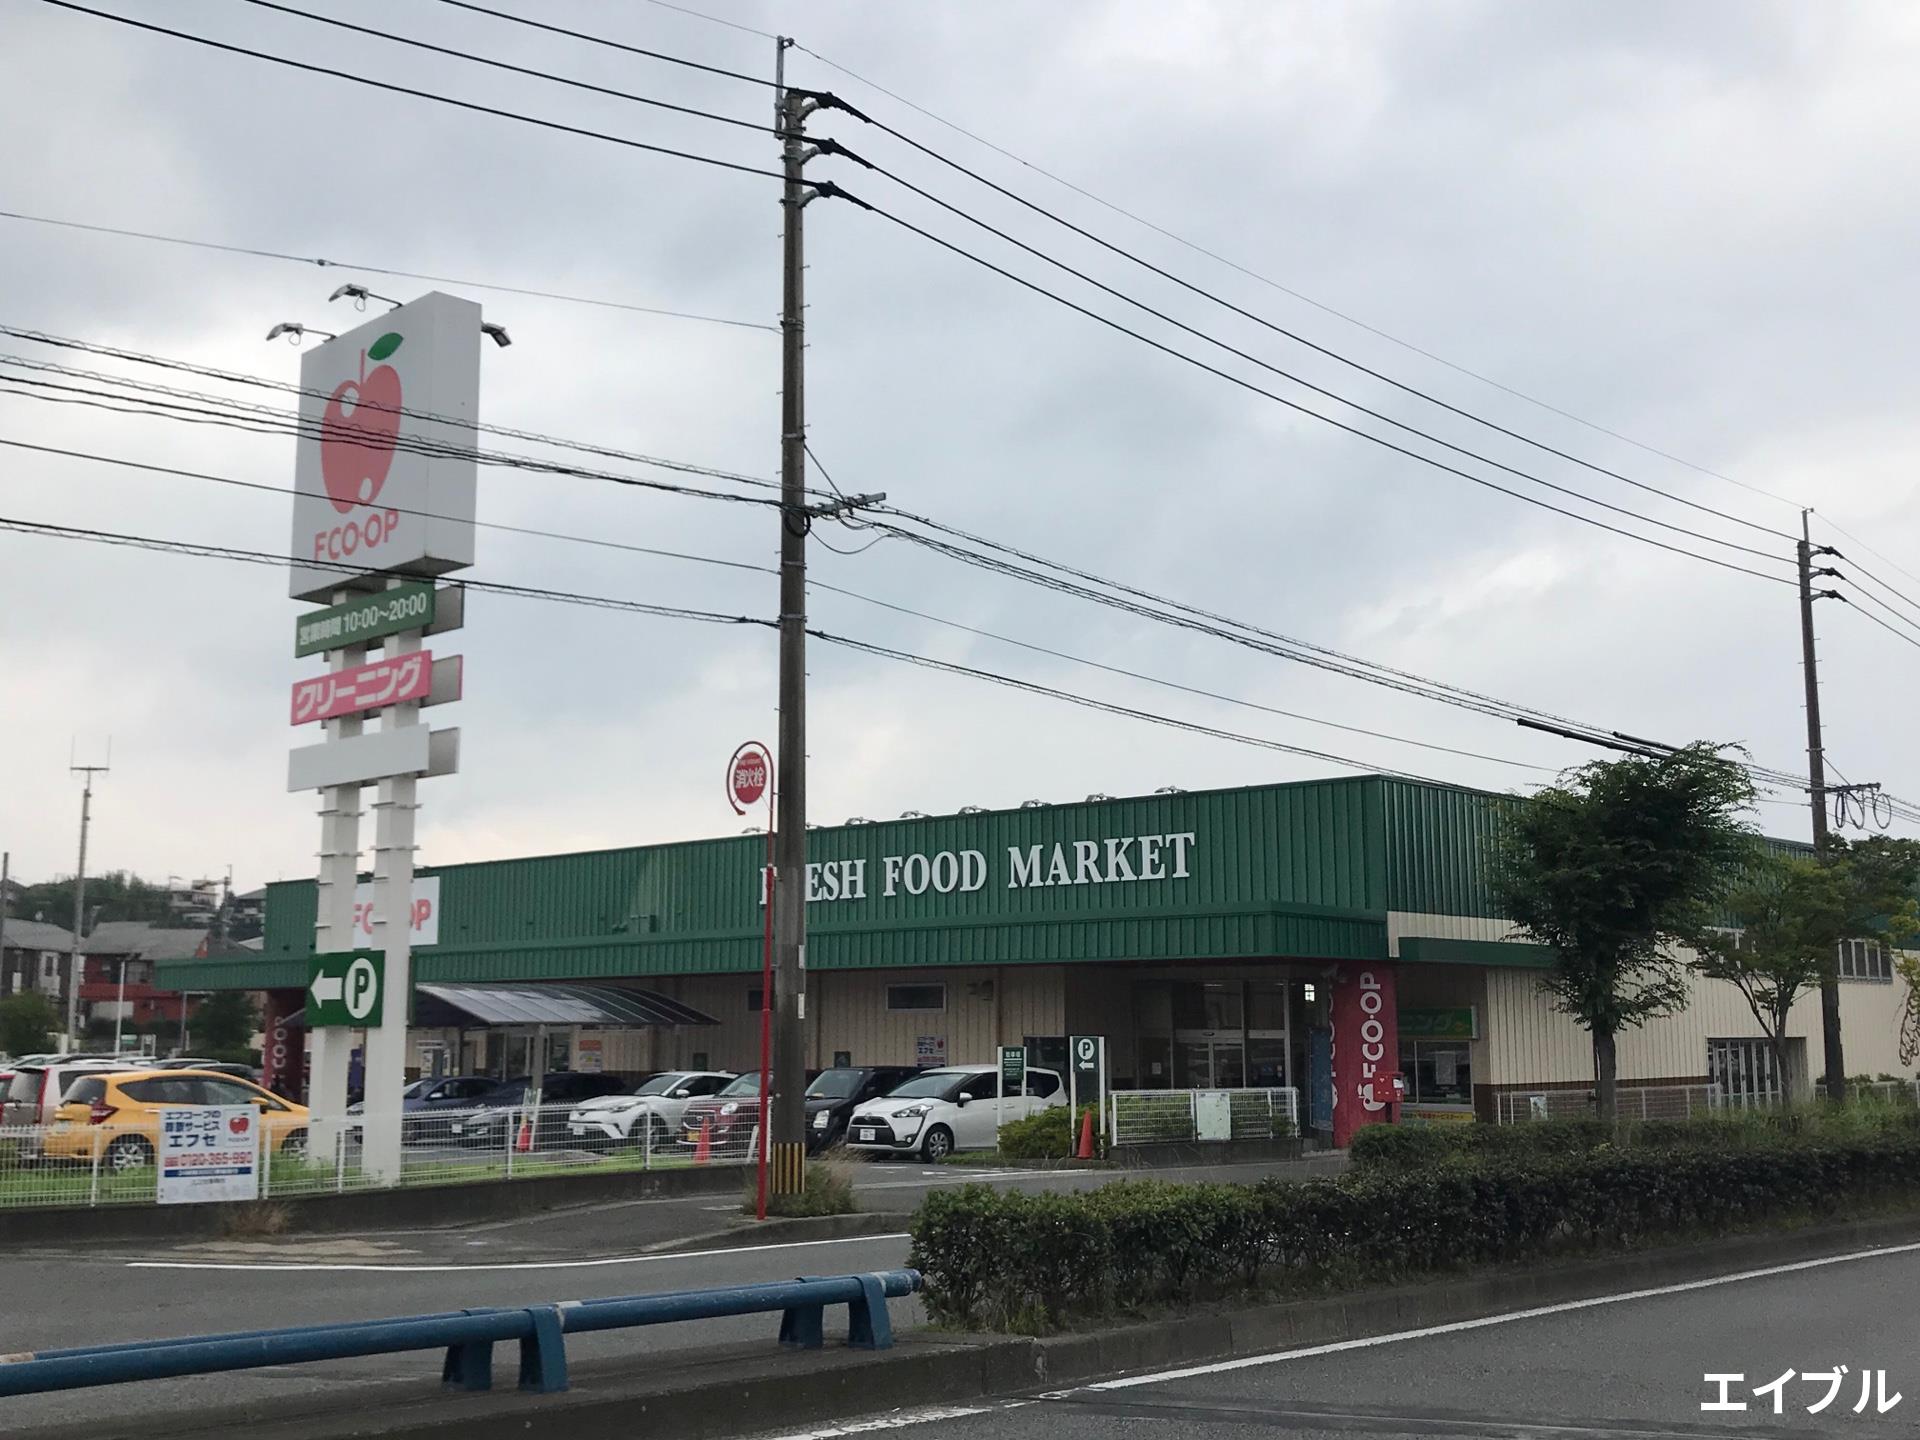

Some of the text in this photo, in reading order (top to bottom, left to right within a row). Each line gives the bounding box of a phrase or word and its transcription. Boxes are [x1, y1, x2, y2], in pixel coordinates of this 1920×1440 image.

[296, 655, 422, 720] クリーニング
[735, 766, 764, 788] 消火栓
[883, 850, 987, 896] FOOD
[1007, 832, 1195, 888] MARKET
[353, 967, 370, 1009] P
[1083, 1042, 1091, 1057] P
[169, 1133, 216, 1147] エフセ
